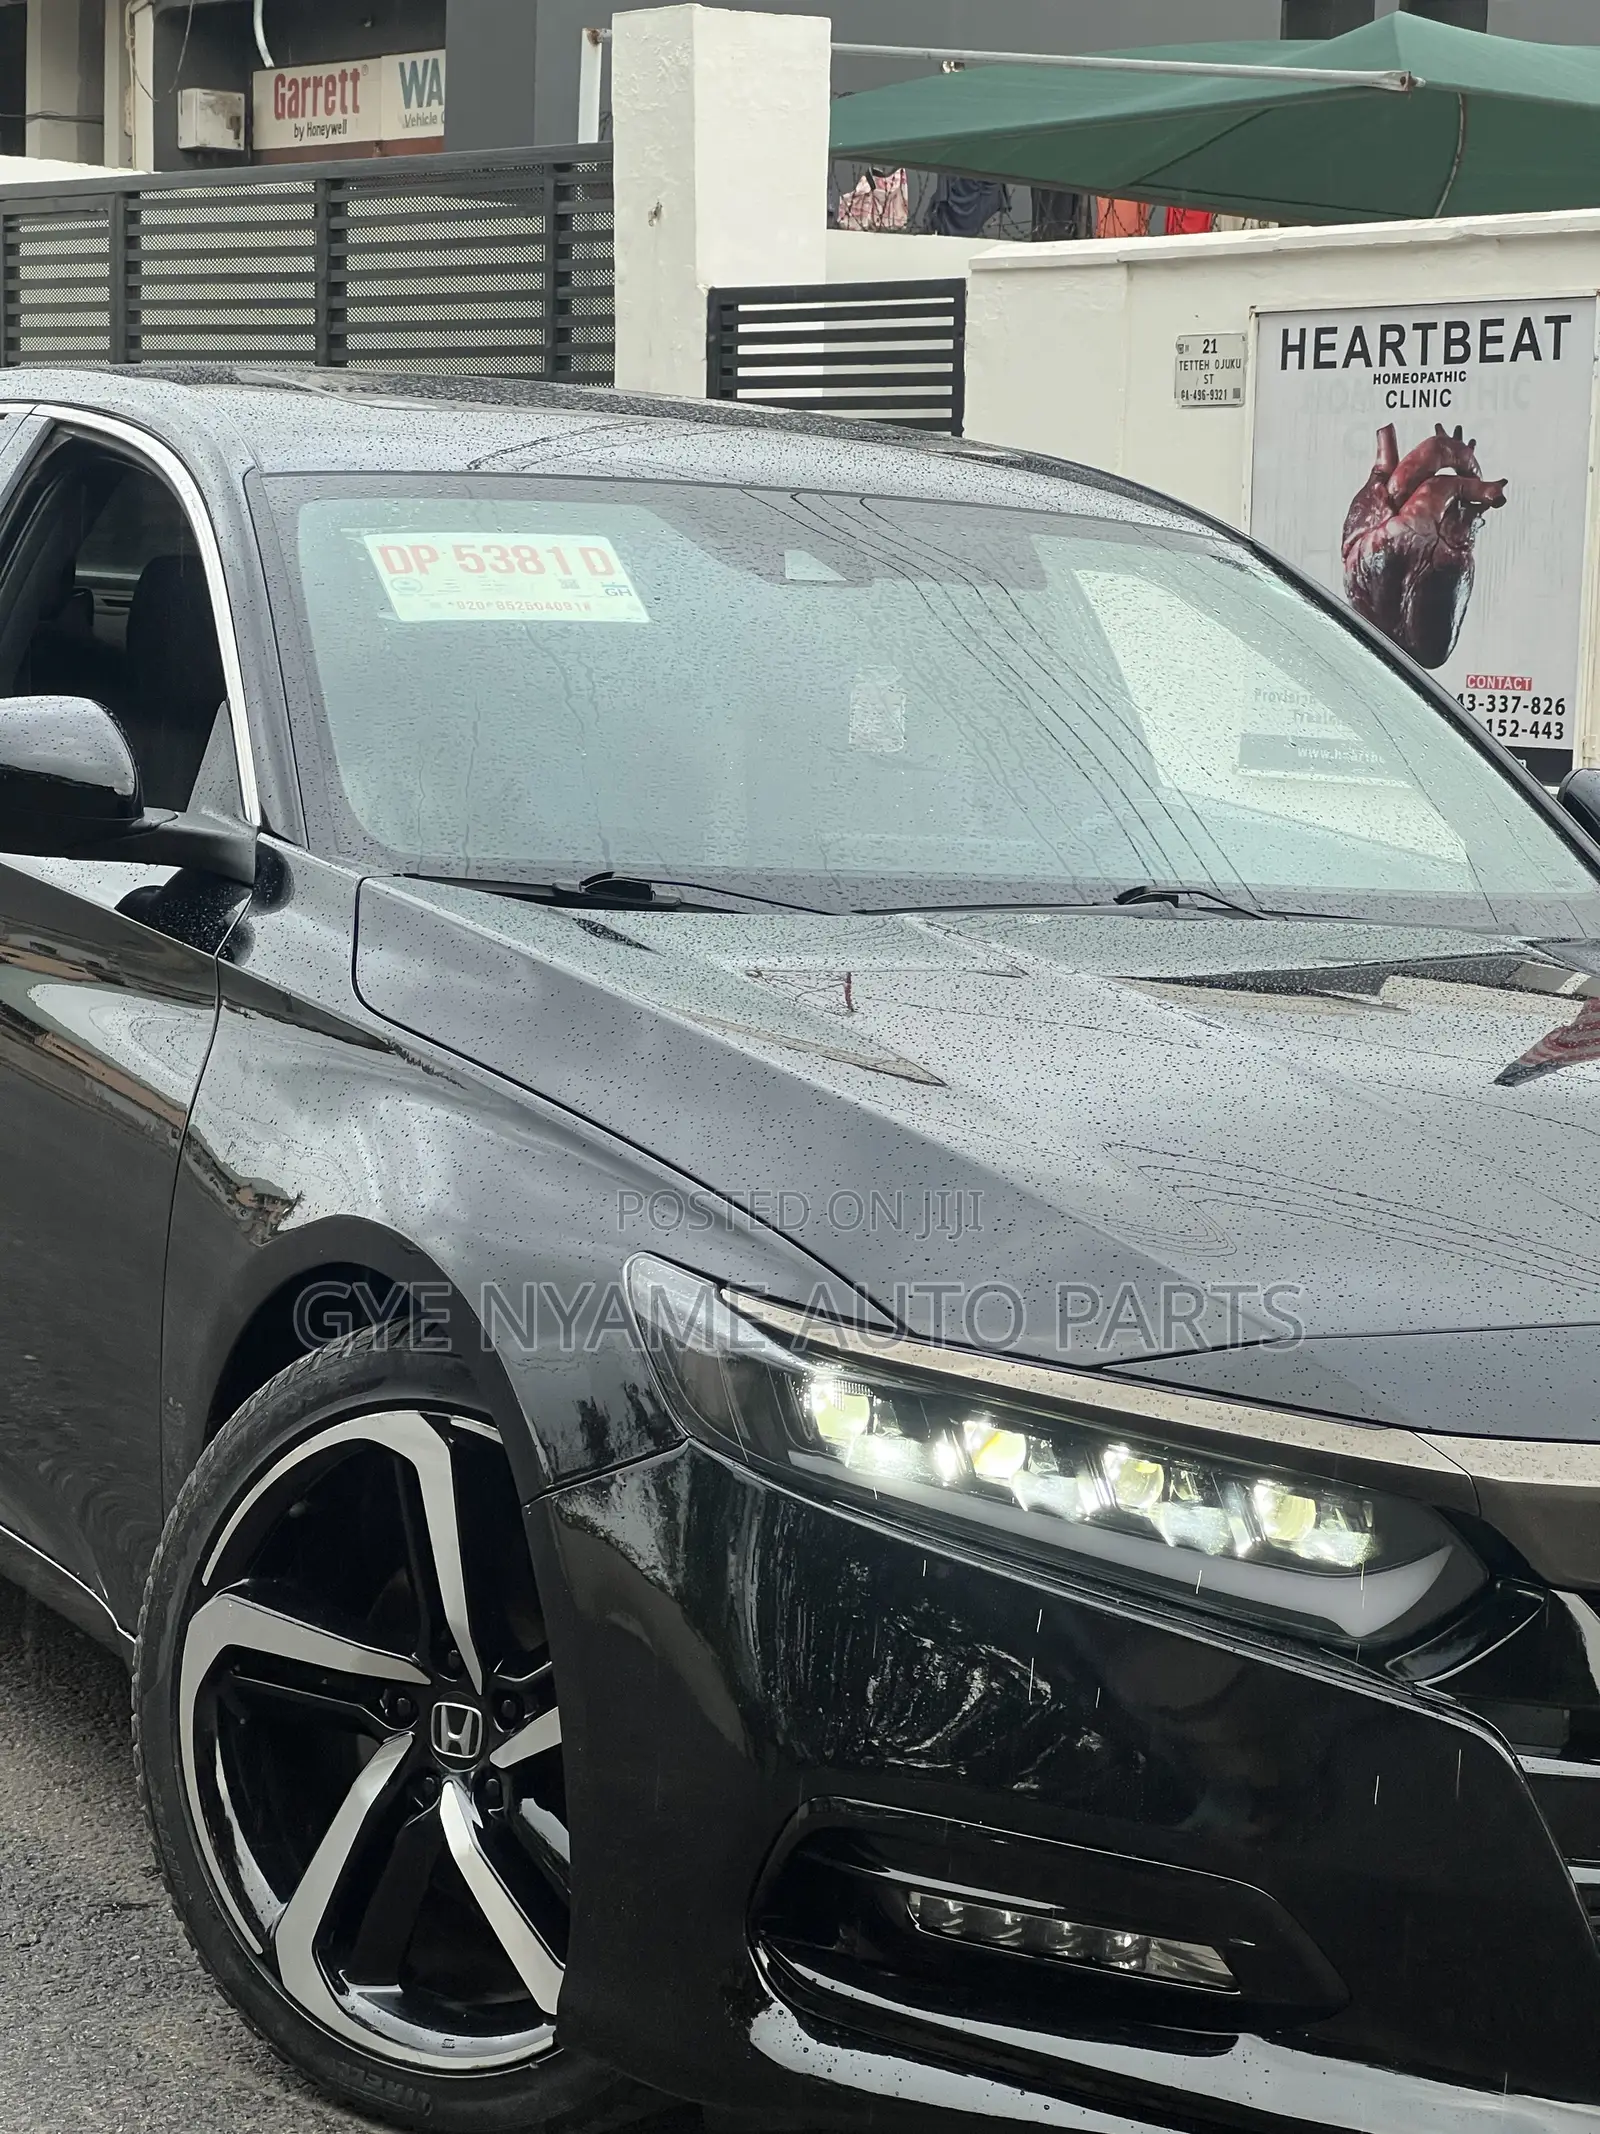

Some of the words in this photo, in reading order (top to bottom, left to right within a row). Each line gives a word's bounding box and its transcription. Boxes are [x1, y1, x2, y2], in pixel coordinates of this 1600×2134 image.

[273, 68, 361, 120] Garrett
[402, 112, 438, 128] Vehicle
[293, 124, 304, 141] by
[306, 119, 348, 138] Honeywell
[1202, 338, 1218, 354] 21
[1280, 315, 1572, 370] HEARTBEAT
[1179, 360, 1210, 371] TETTEH
[1203, 374, 1214, 384] ST
[1372, 370, 1468, 385] HOMEOPATHIC
[1385, 388, 1453, 409] CLINIC
[450, 544, 574, 576] 5381
[577, 546, 616, 576] D
[1467, 674, 1532, 691] CONTACT
